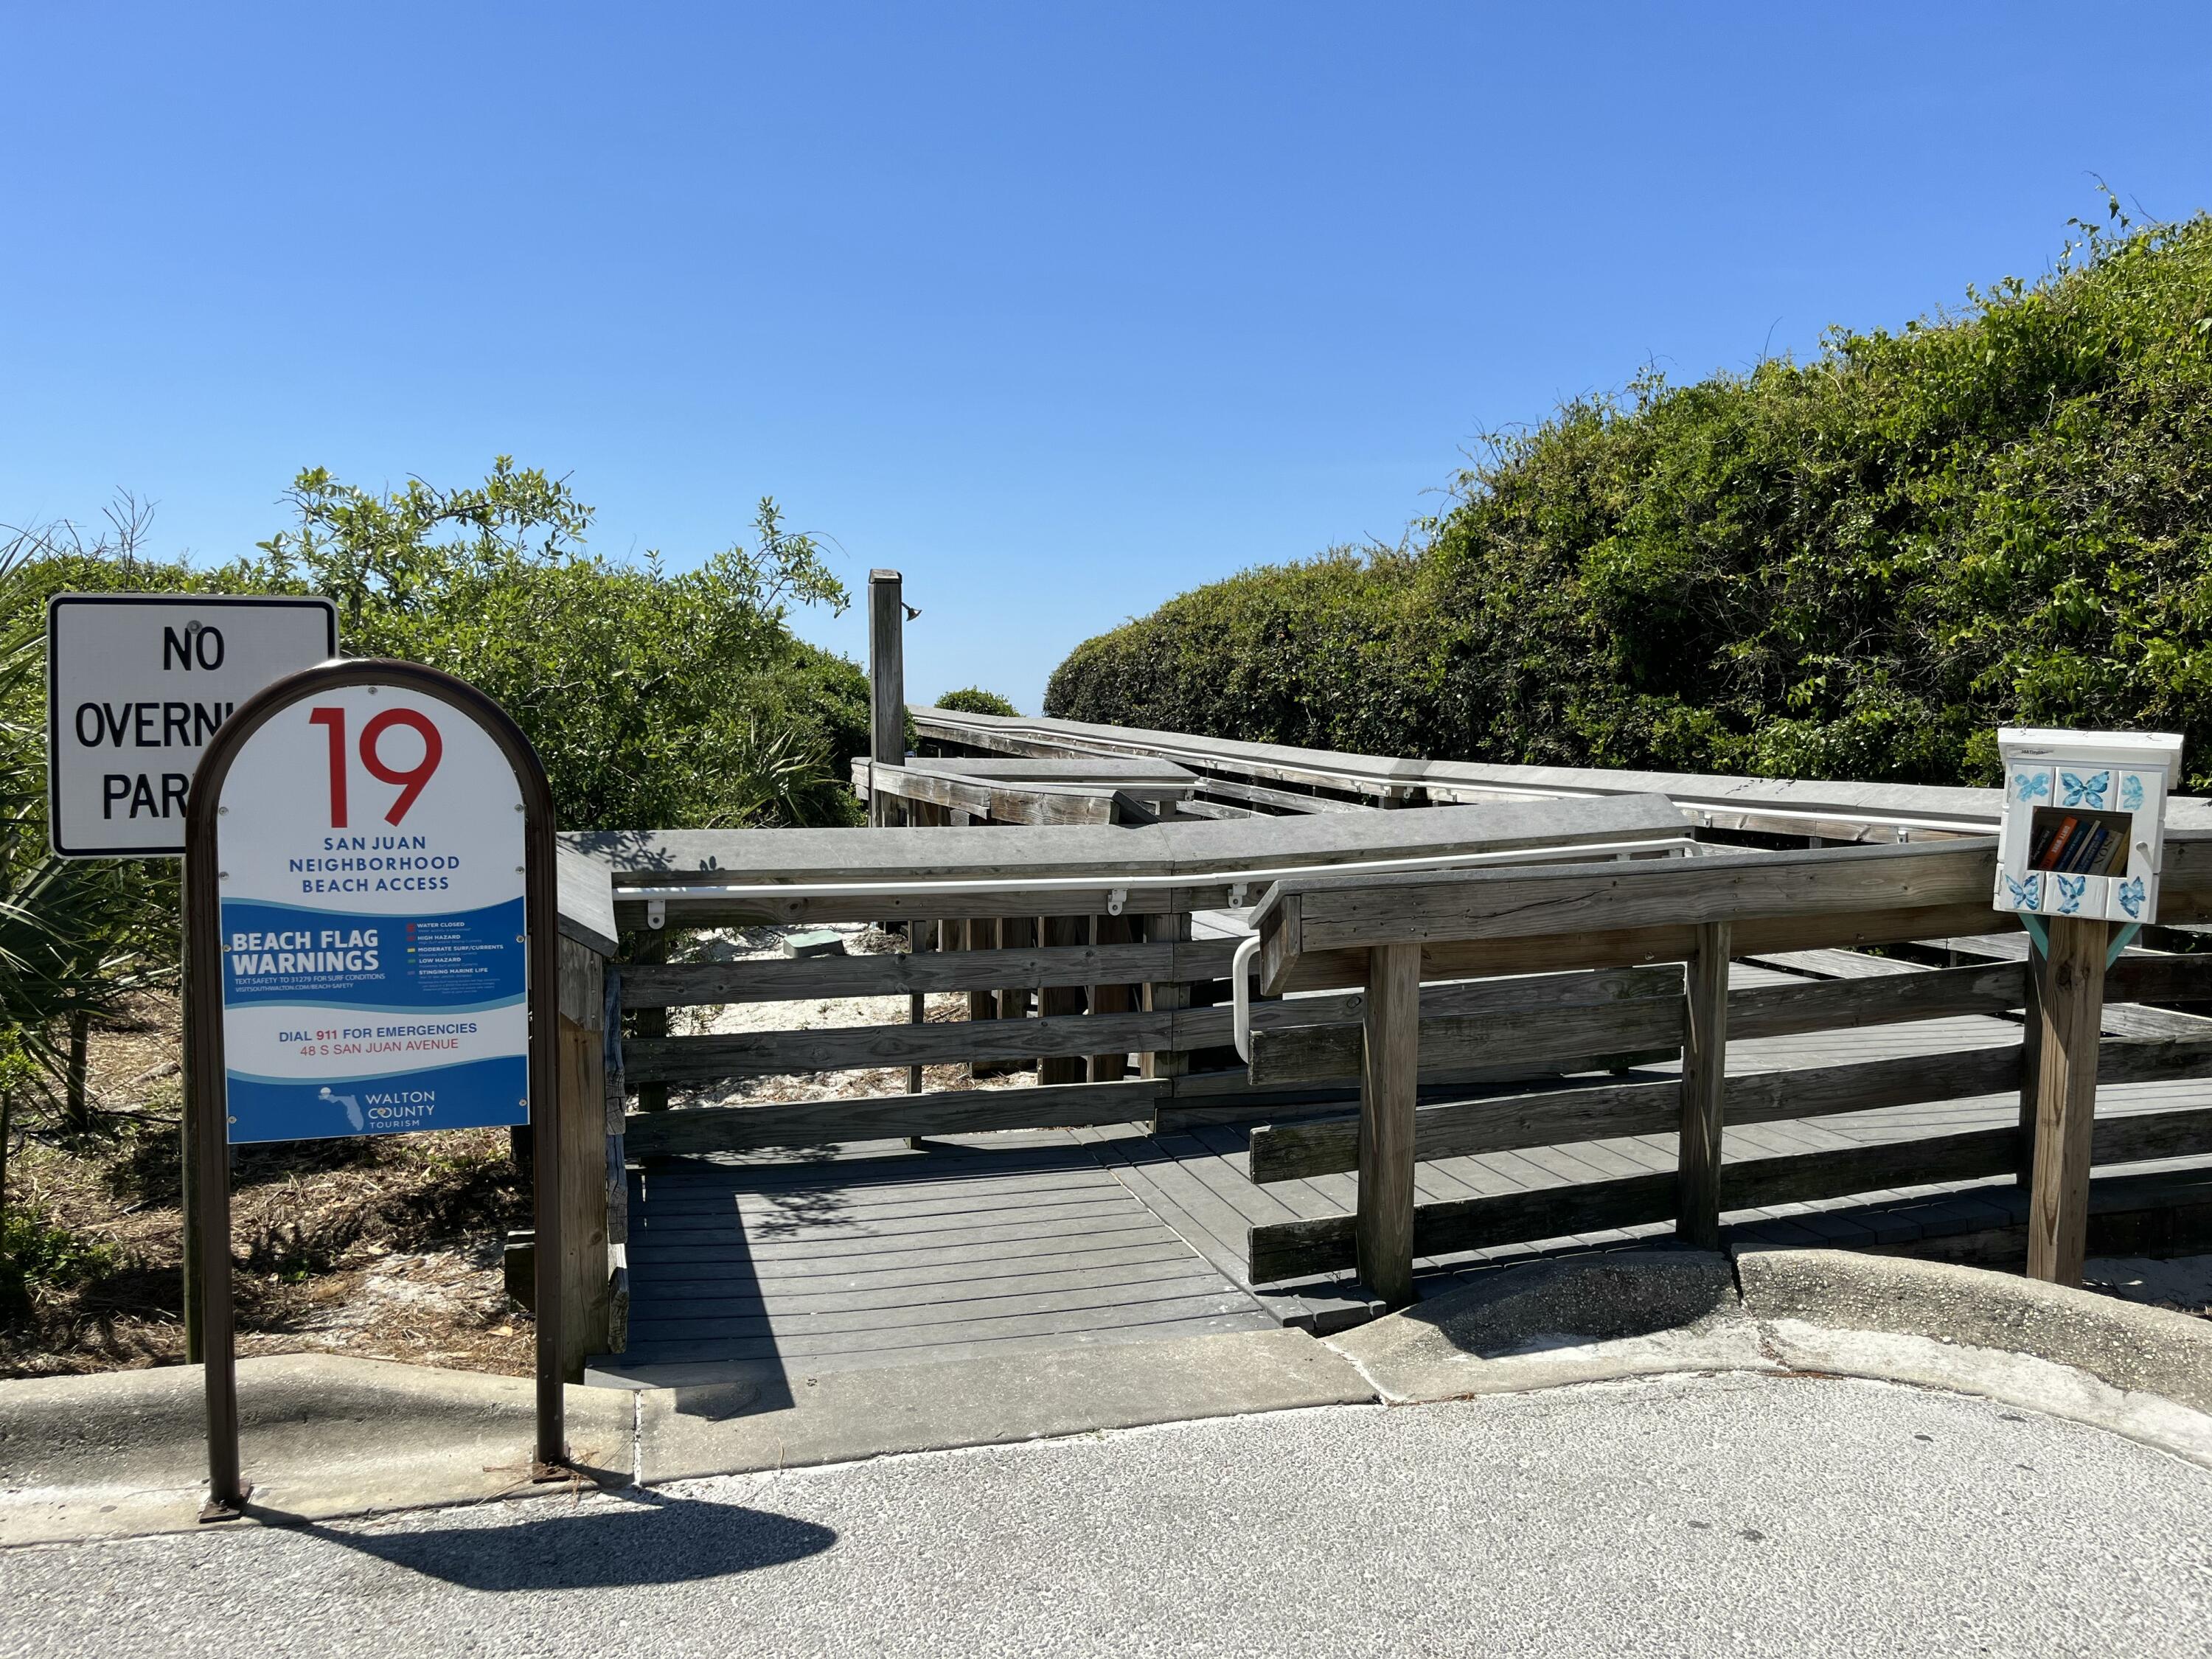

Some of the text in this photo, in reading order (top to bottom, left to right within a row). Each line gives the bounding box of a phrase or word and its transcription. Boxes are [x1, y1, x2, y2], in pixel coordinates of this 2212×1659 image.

[163, 625, 225, 672] NO
[308, 707, 442, 828] 19
[103, 773, 195, 819] PAR
[324, 836, 425, 851] SAN JUAN
[289, 856, 460, 872] NEIGHBORHOOD
[302, 877, 449, 893] BEACH ACCESS
[232, 929, 378, 951] BEACH FLAG
[453, 944, 504, 952] SURF/CURRENTS
[232, 950, 379, 975] WARNINGS
[345, 973, 386, 981] CONDITIONS
[279, 1022, 478, 1042] DIAL 911 FOR EMERGENCIES
[300, 1038, 459, 1056] 48 S SAN JUAN AVENUE
[366, 1091, 435, 1105] WALTON
[368, 1105, 435, 1119] COUNTY
[369, 1119, 420, 1129] TOURISM
